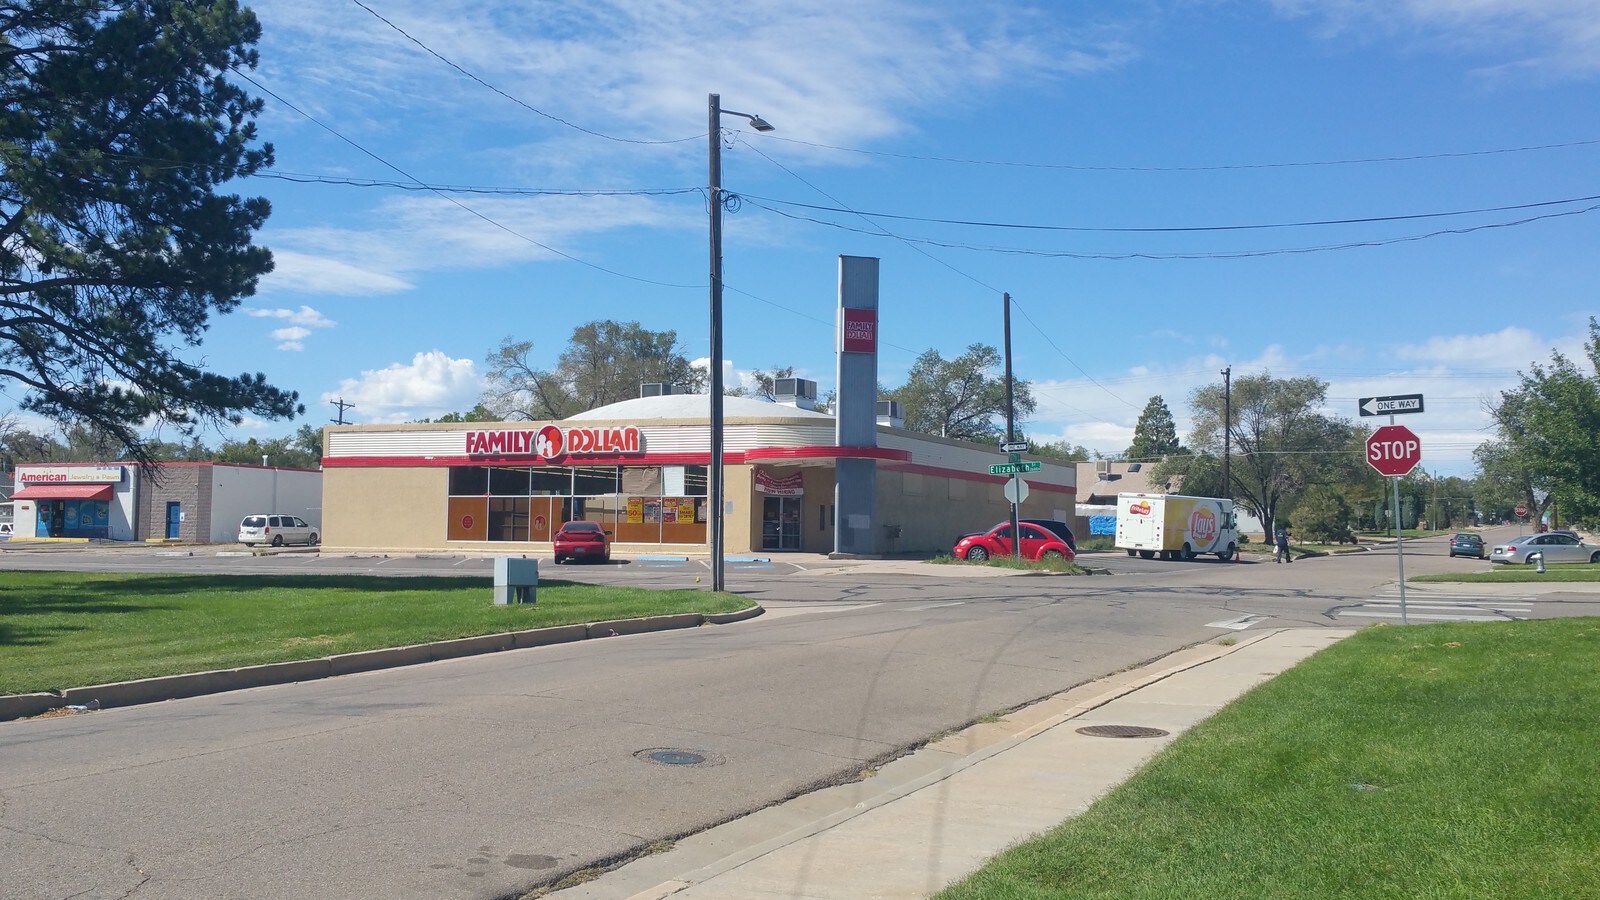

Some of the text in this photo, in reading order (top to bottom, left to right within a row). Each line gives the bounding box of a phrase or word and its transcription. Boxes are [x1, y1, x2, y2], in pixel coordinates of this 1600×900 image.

[846, 320, 874, 331] FAMILY
[846, 330, 872, 341] DOLLAR
[1377, 400, 1417, 410] ONE WAY
[465, 426, 640, 454] FAMILY DOLLAR
[1370, 440, 1417, 461] STOP
[990, 464, 1030, 474] Elizabeth
[20, 473, 67, 482] American
